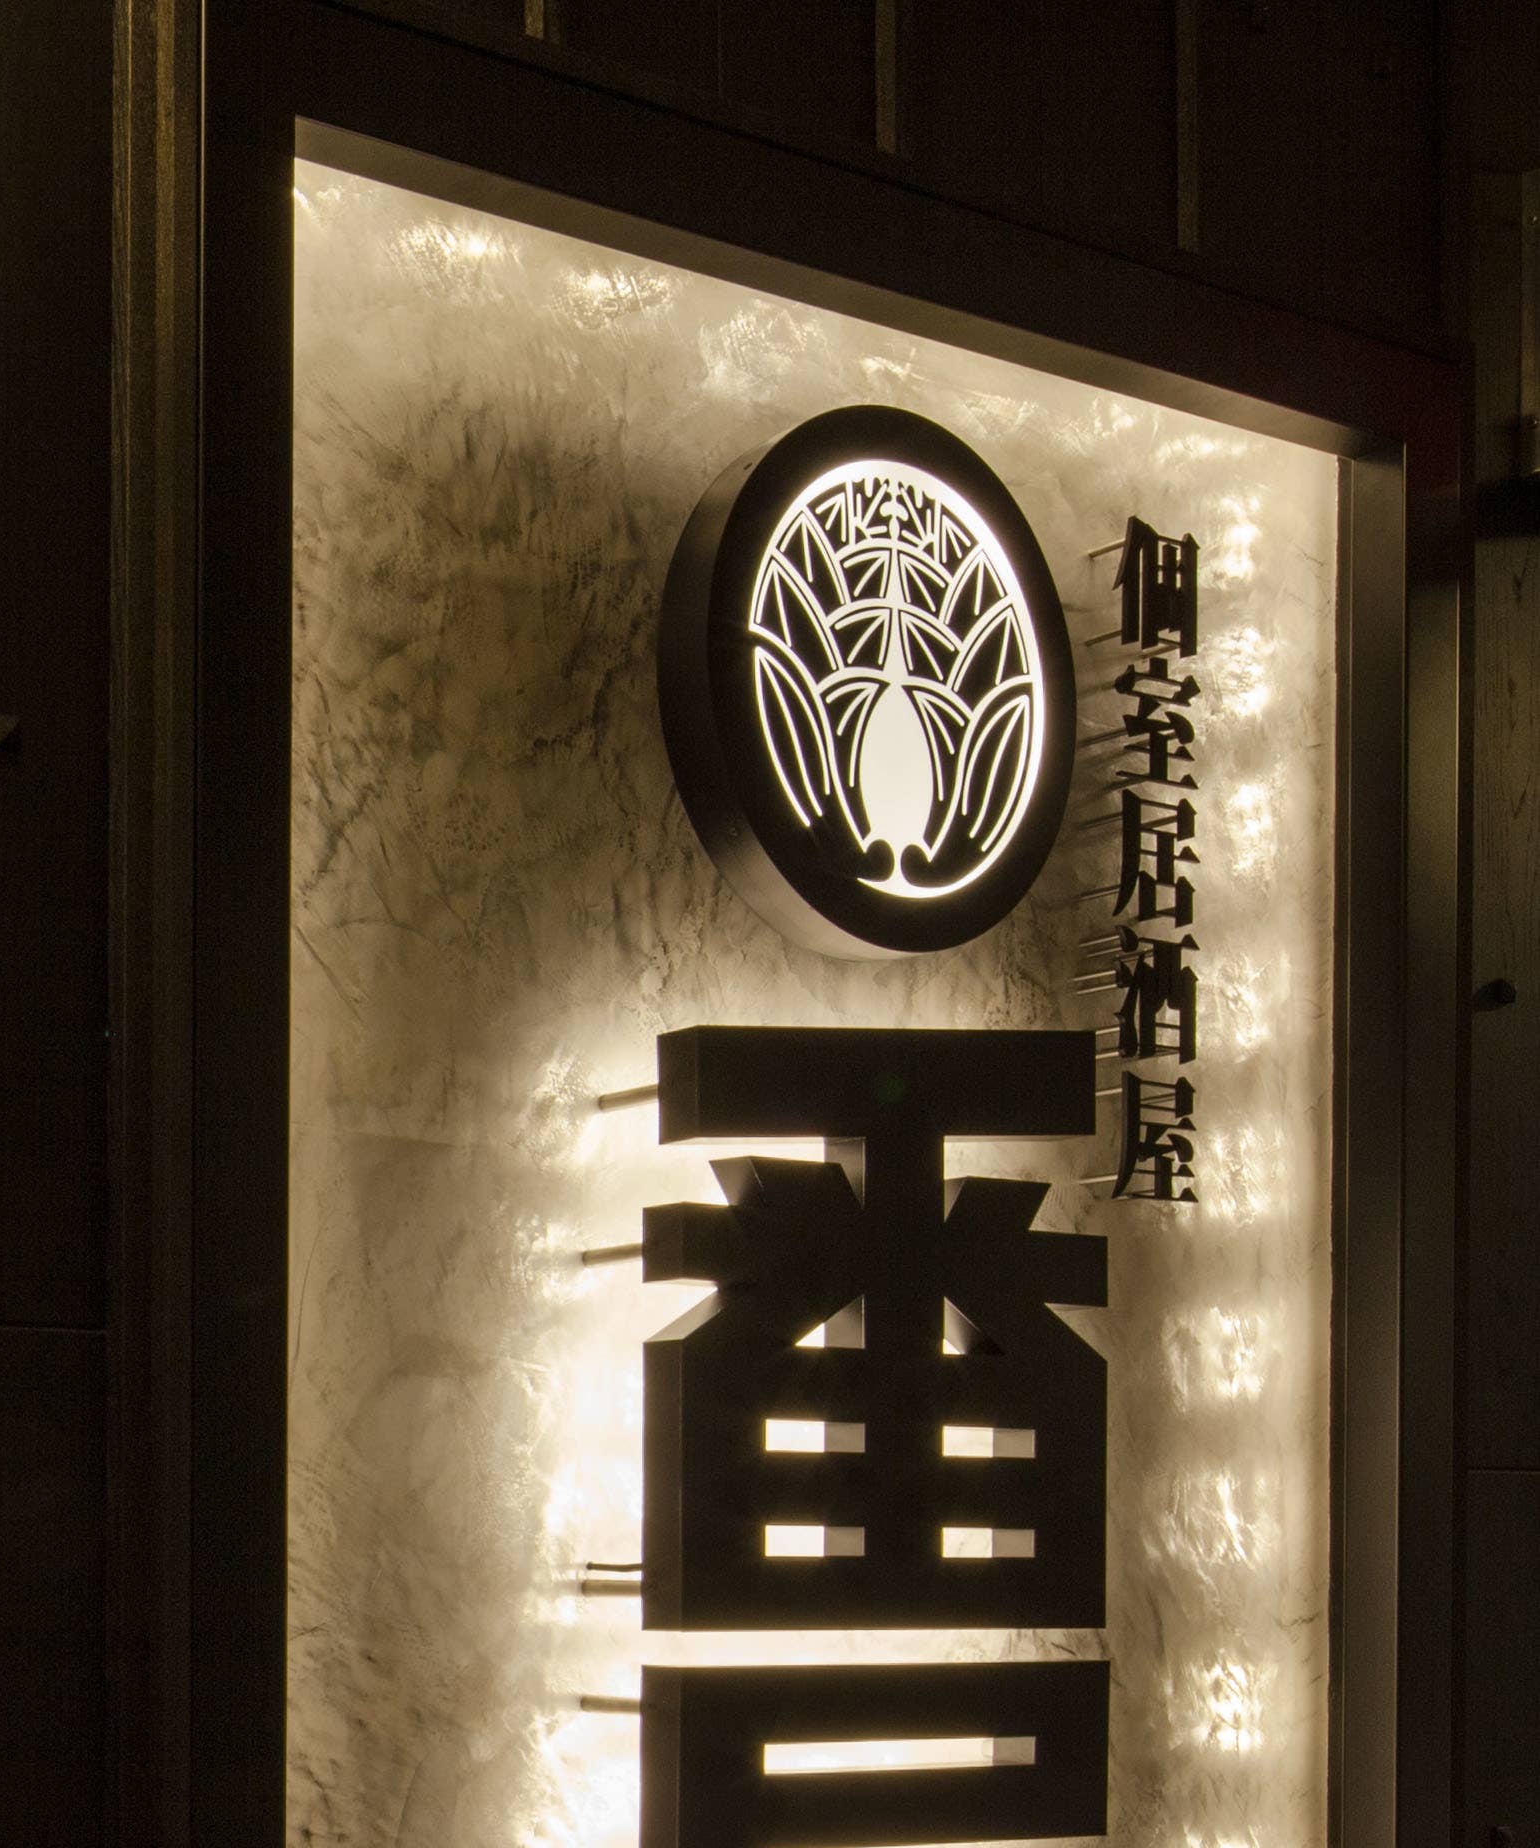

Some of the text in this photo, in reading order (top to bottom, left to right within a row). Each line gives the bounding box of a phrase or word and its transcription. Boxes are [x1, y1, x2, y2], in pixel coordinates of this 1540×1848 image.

[1115, 512, 1200, 1206] 個室居酒屋
